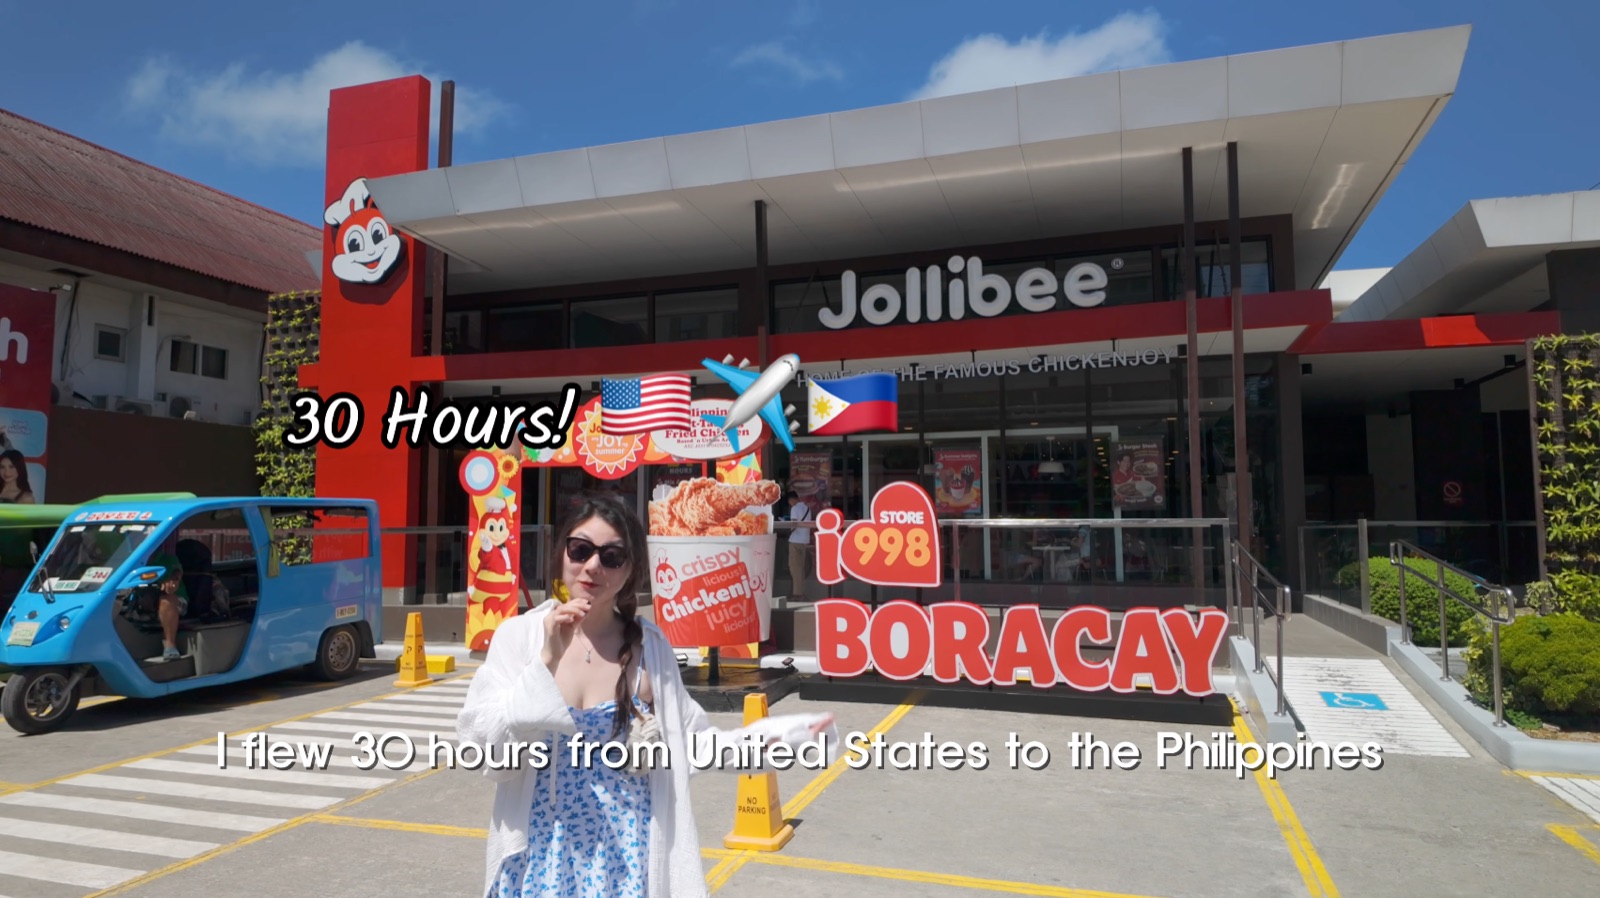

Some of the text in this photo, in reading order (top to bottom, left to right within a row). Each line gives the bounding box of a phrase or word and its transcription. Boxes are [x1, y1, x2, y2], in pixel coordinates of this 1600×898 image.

[817, 255, 1109, 330] Jollibee
[892, 366, 928, 382] THE
[933, 359, 1021, 380] FAMOUS
[1027, 347, 1175, 374] CHICKENJOY
[665, 429, 697, 440] Fried
[879, 510, 924, 525] STORE
[681, 546, 741, 577] crispy
[853, 527, 931, 567] 998
[661, 568, 769, 622] Chickenjoy
[704, 599, 749, 631] juicy
[813, 597, 1229, 699] BORACAY
[738, 806, 766, 815] PARKING
[747, 797, 757, 805] NO
